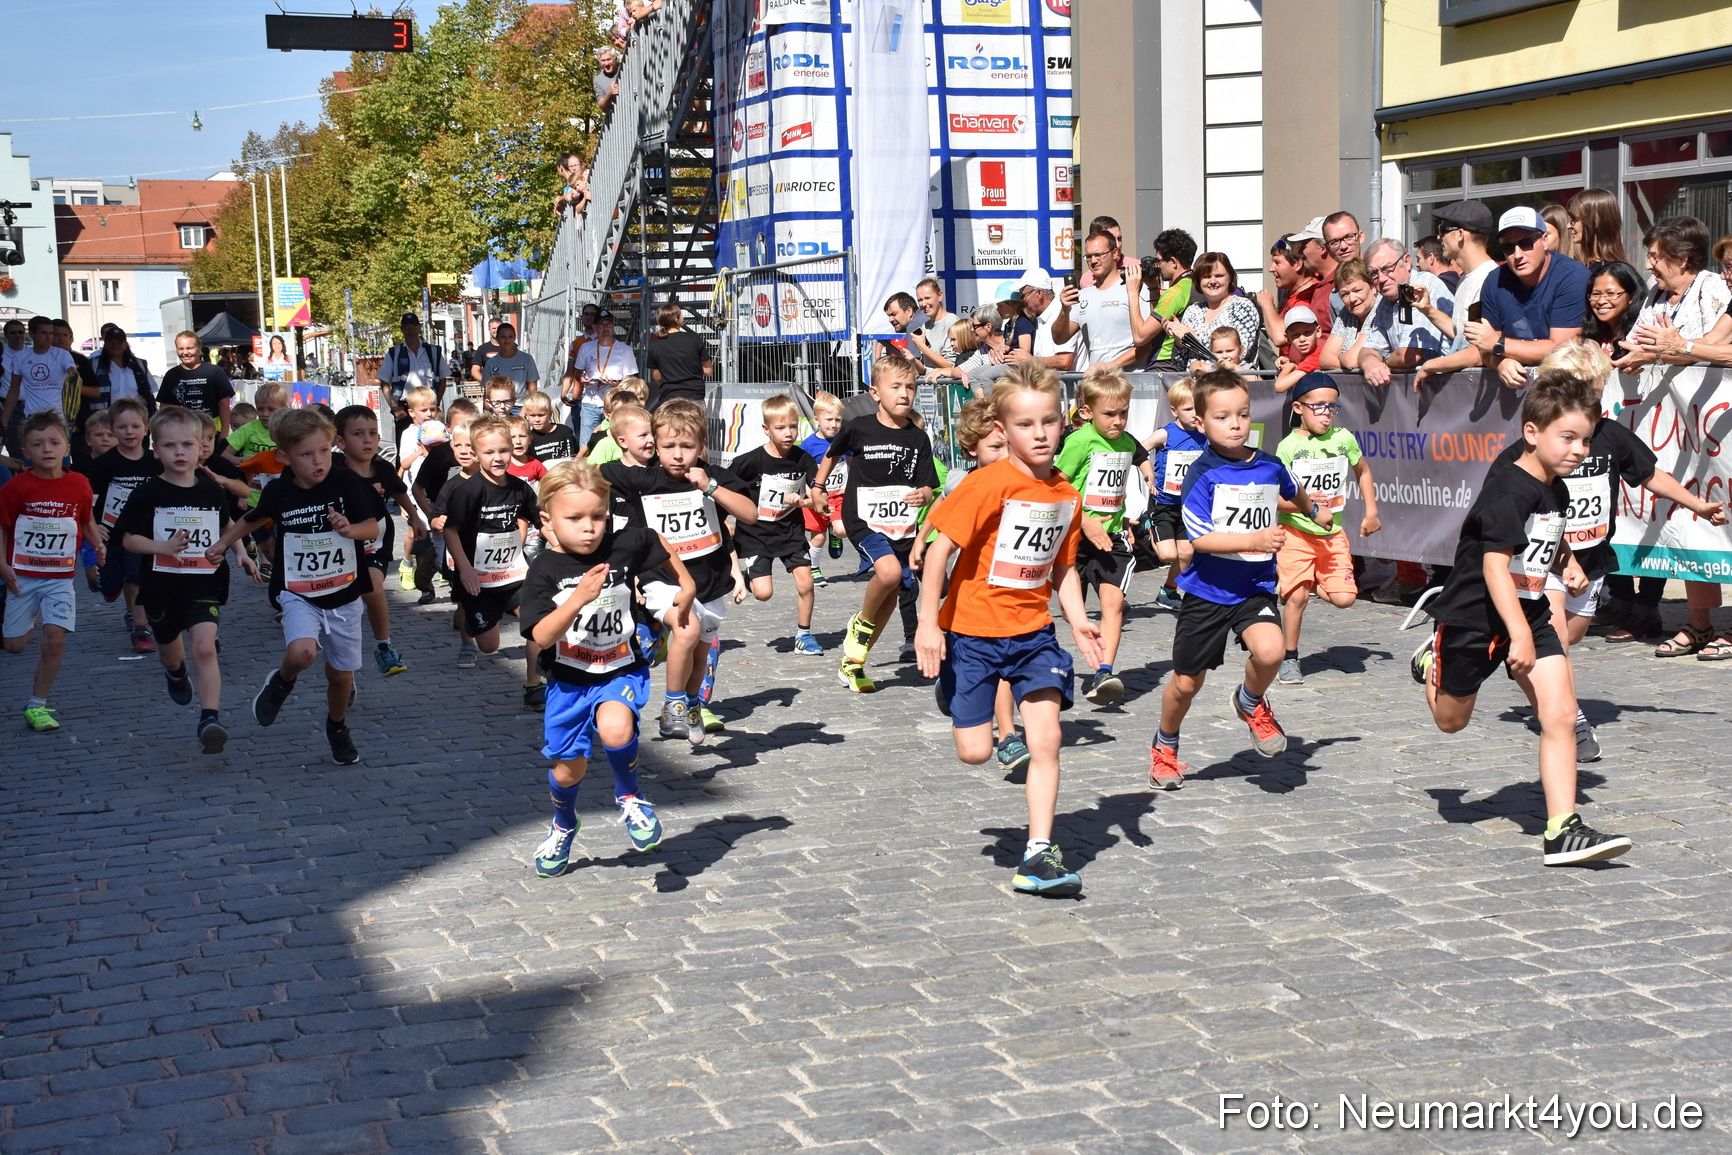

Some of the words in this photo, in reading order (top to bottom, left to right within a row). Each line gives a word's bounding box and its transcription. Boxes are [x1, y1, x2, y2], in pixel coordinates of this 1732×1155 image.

[393, 22, 406, 48] 3
[793, 67, 830, 79] energie
[991, 70, 1029, 80] energie
[952, 113, 1010, 128] charivari
[786, 128, 802, 140] DEHN
[783, 181, 836, 193] VARIOTEC
[981, 186, 1005, 198] Braun
[977, 248, 1017, 256] Neumarkter
[971, 254, 1024, 267] Lammsbräu
[802, 298, 832, 308] CODE
[803, 308, 837, 319] CLINIC
[1651, 401, 1730, 457] UNS
[863, 443, 903, 452] Neumarkter
[1351, 430, 1428, 460] NDUSTRY
[864, 451, 896, 460] Stadtlauf
[1174, 463, 1190, 478] 70
[1310, 462, 1336, 470] BOCK
[1301, 472, 1341, 491] 7465
[661, 498, 693, 508] BOCK
[768, 489, 785, 505] 71
[281, 503, 326, 520] Neumarkter
[867, 500, 910, 519] 7502
[174, 515, 204, 524] BOCK
[656, 508, 708, 534] 7573
[1225, 505, 1271, 530] 7400
[32, 521, 61, 530] BOCK
[23, 530, 68, 550] 7377
[1012, 524, 1064, 552] 7437
[1564, 527, 1597, 543] TON
[301, 538, 334, 549] BOCK
[483, 545, 517, 565] 7427
[1013, 554, 1032, 562] PARTL
[1526, 537, 1558, 566] 75
[29, 557, 60, 566] Valentin
[293, 547, 346, 572] 7374
[316, 569, 337, 578] Neumarkt
[1640, 555, 1732, 579] www.jura-geb
[310, 580, 335, 591] Louis
[572, 608, 624, 638] 7448
[574, 648, 617, 664] Johannes
